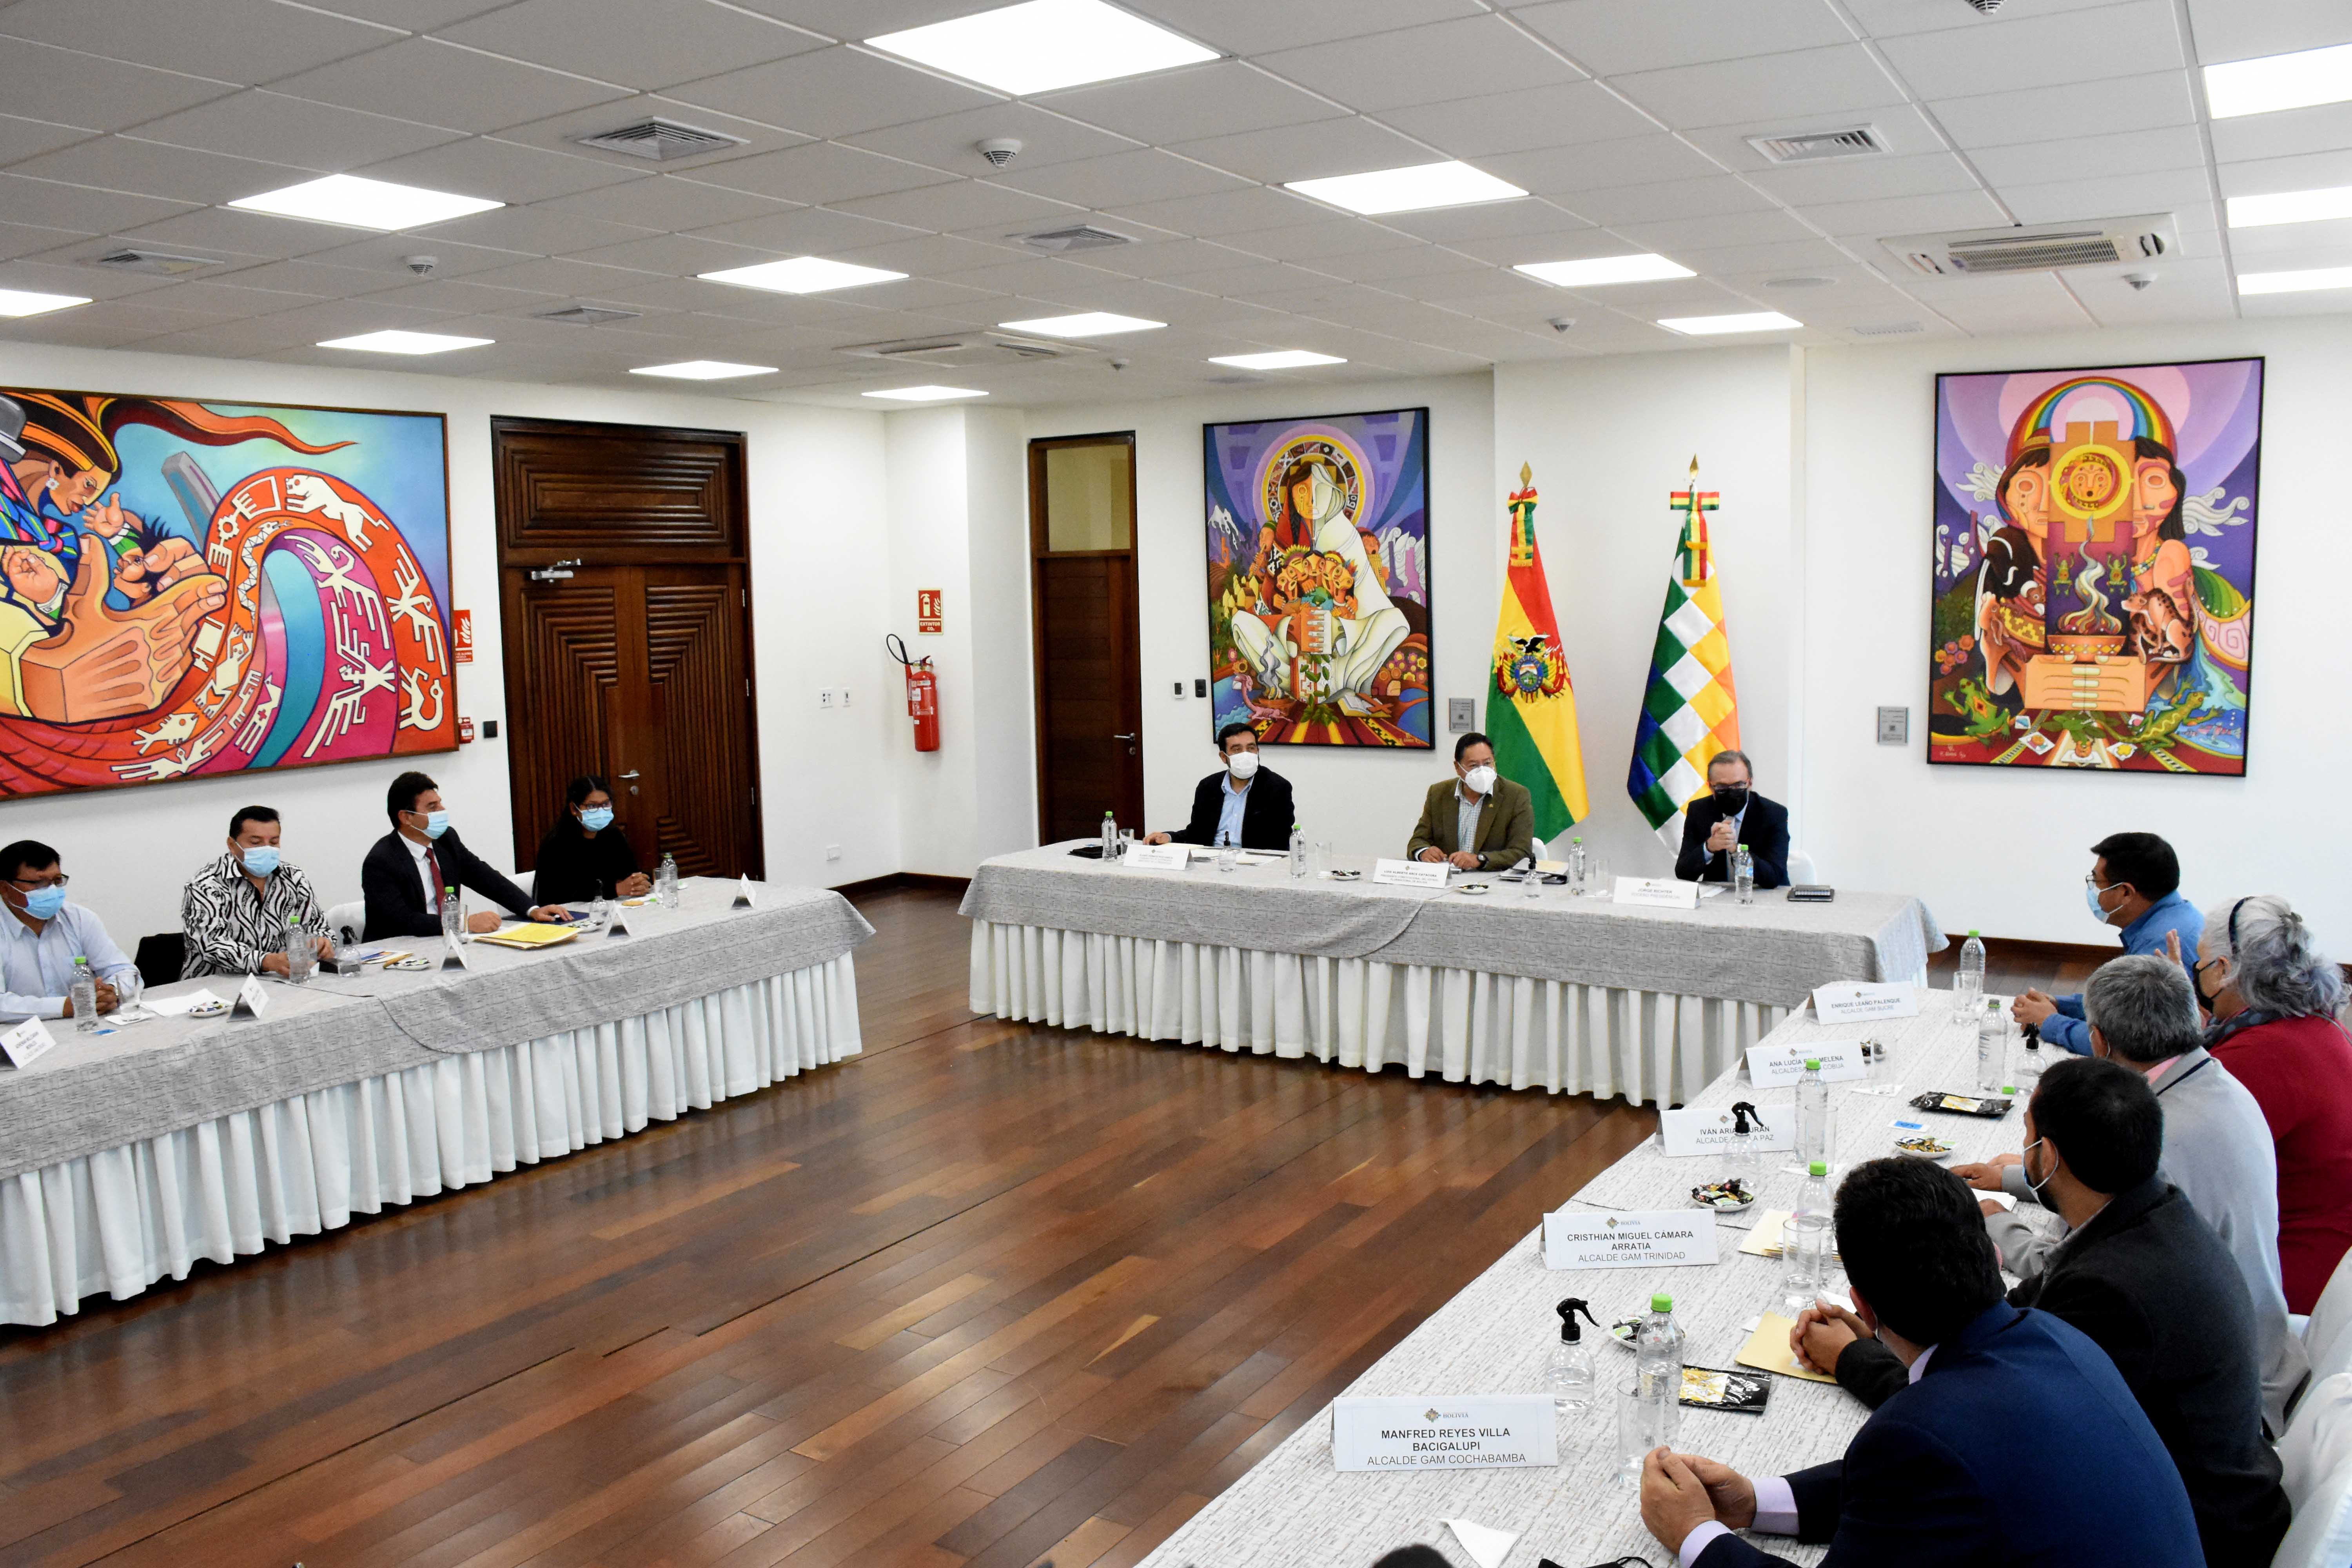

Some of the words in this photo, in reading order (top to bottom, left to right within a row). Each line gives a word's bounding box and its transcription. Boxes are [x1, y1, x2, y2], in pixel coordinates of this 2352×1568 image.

[1568, 1233, 1615, 1241] CRISTHIAN
[1618, 1232, 1652, 1240] MIGUEL
[1578, 1254, 1618, 1262] ALCALDE
[1621, 1252, 1641, 1261] GAM
[1644, 1252, 1685, 1260] TRINIDAD
[1381, 1429, 1436, 1439] MANFRED
[1439, 1428, 1475, 1438] REYES
[1479, 1427, 1510, 1437] VILLA
[1413, 1441, 1480, 1451] BACIGALUPI
[1367, 1455, 1417, 1465] ALCALDE
[1421, 1455, 1445, 1464] GAM
[1449, 1453, 1526, 1464] COCHABAMBA
